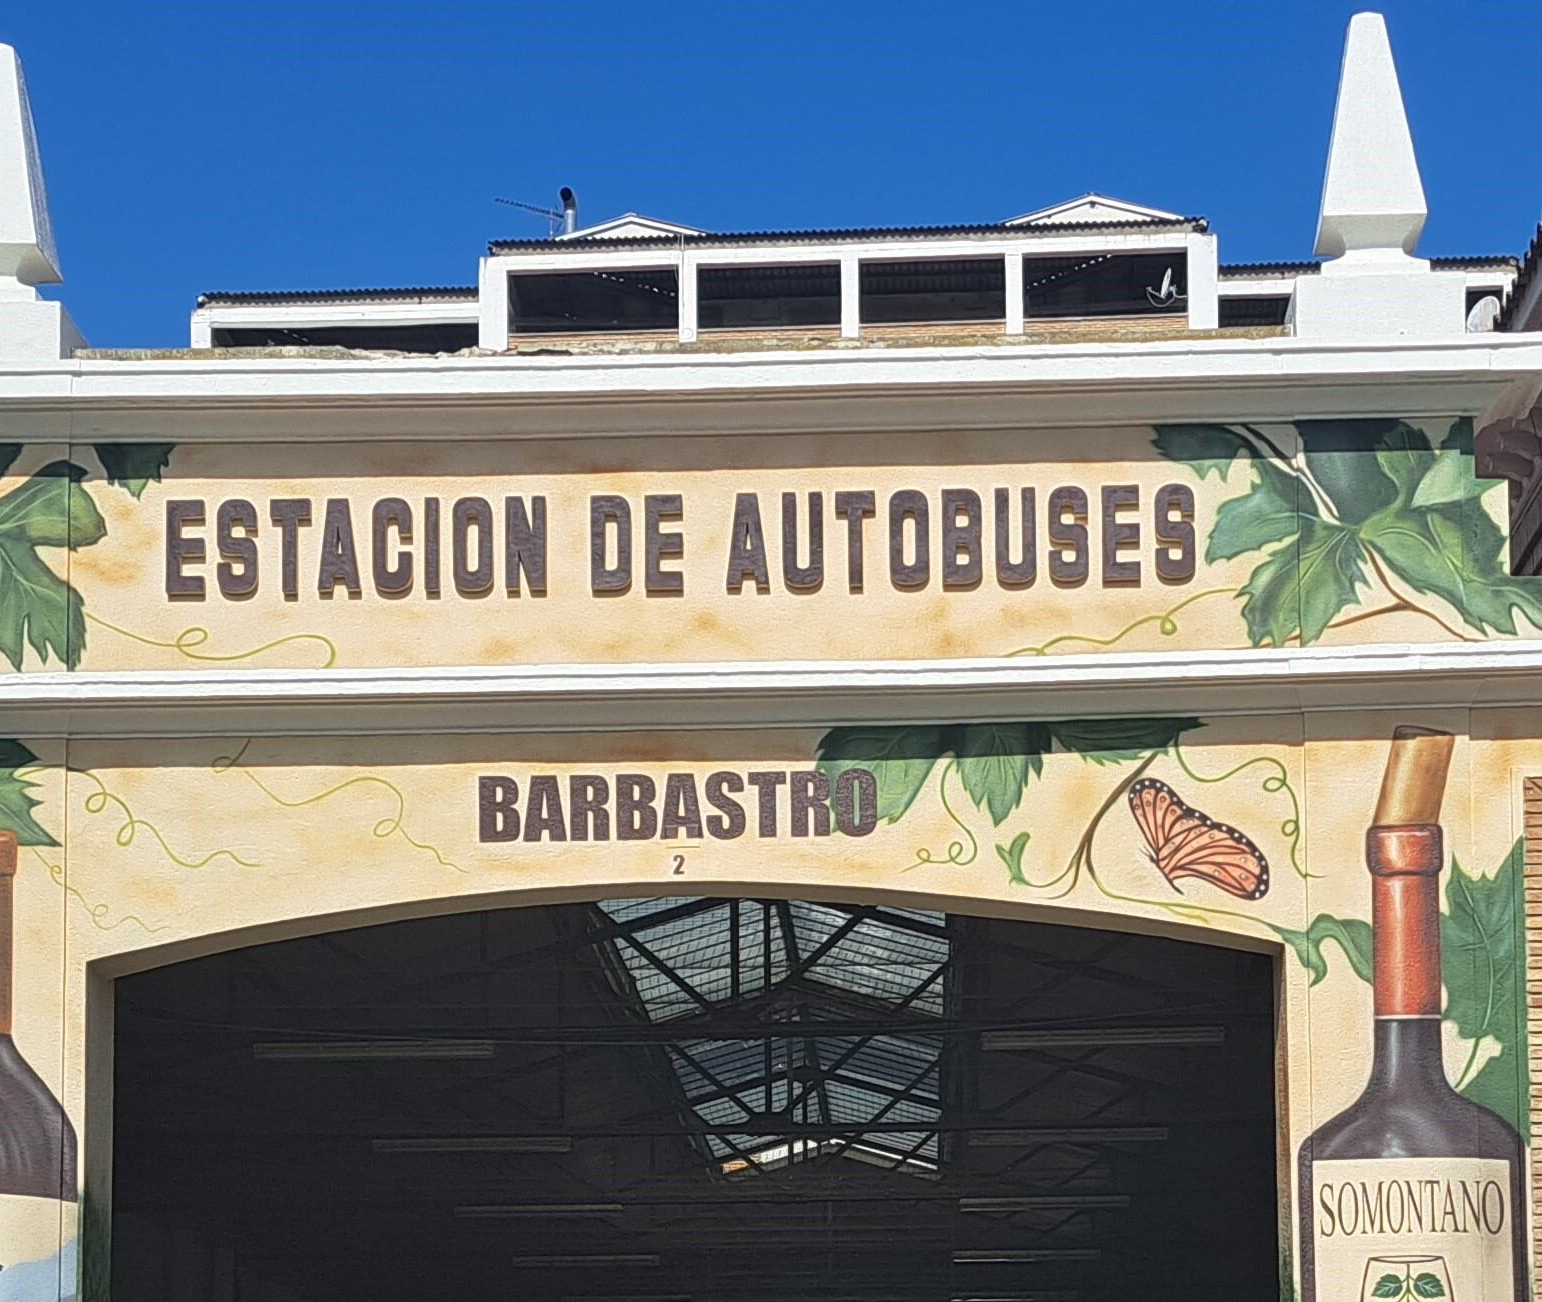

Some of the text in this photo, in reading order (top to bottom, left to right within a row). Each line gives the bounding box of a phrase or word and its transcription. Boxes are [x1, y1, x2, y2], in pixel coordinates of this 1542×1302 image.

[165, 483, 1196, 602] ESTACION DE AUTOBUSES
[478, 767, 878, 843] BARBASTRO
[672, 854, 685, 875] 2
[1319, 1179, 1505, 1238] SOMONTANO
